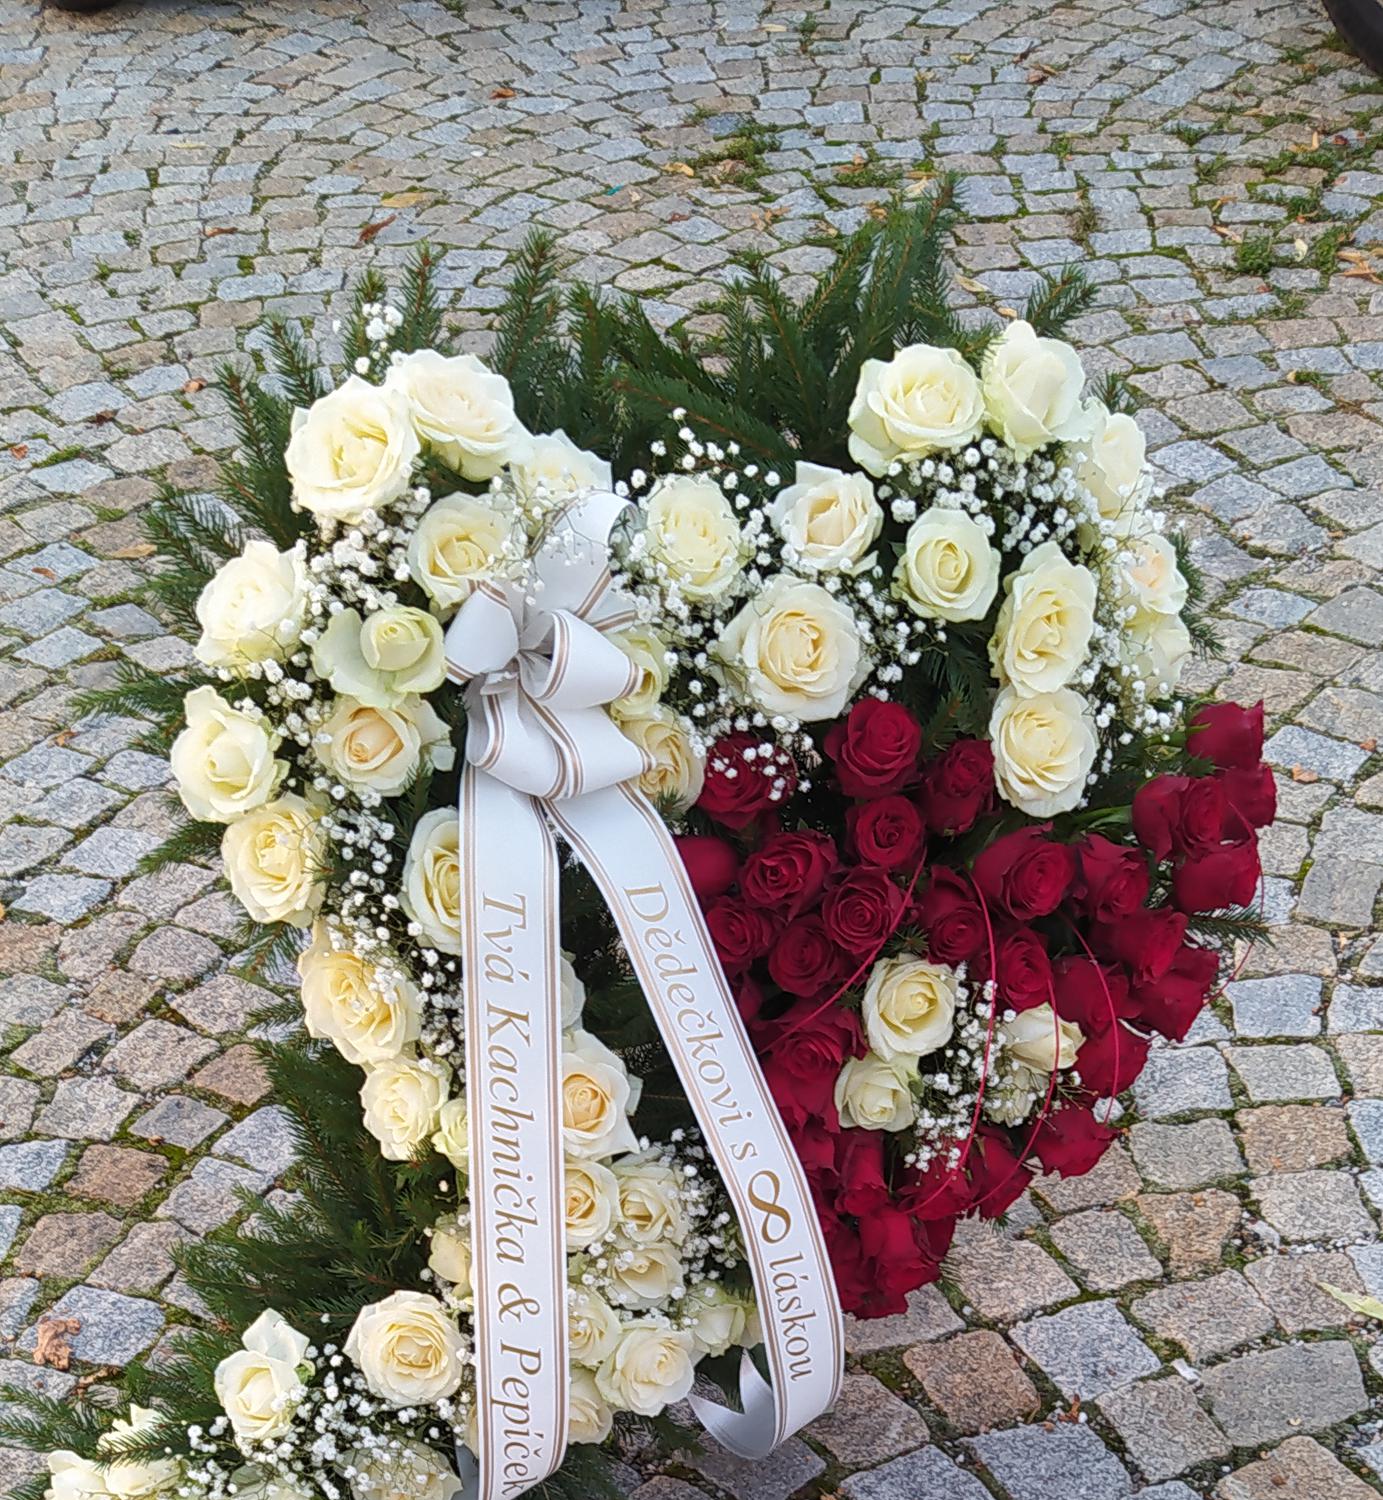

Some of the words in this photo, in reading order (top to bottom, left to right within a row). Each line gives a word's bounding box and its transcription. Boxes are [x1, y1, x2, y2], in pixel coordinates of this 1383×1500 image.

[482, 891, 530, 985] Tvá
[486, 999, 540, 1265] Kachnička
[623, 881, 754, 1128] Dědečkovi
[730, 1141, 758, 1161] s
[769, 1251, 817, 1383] láskou
[498, 1282, 541, 1324] &
[491, 1338, 545, 1497] Pepíček
